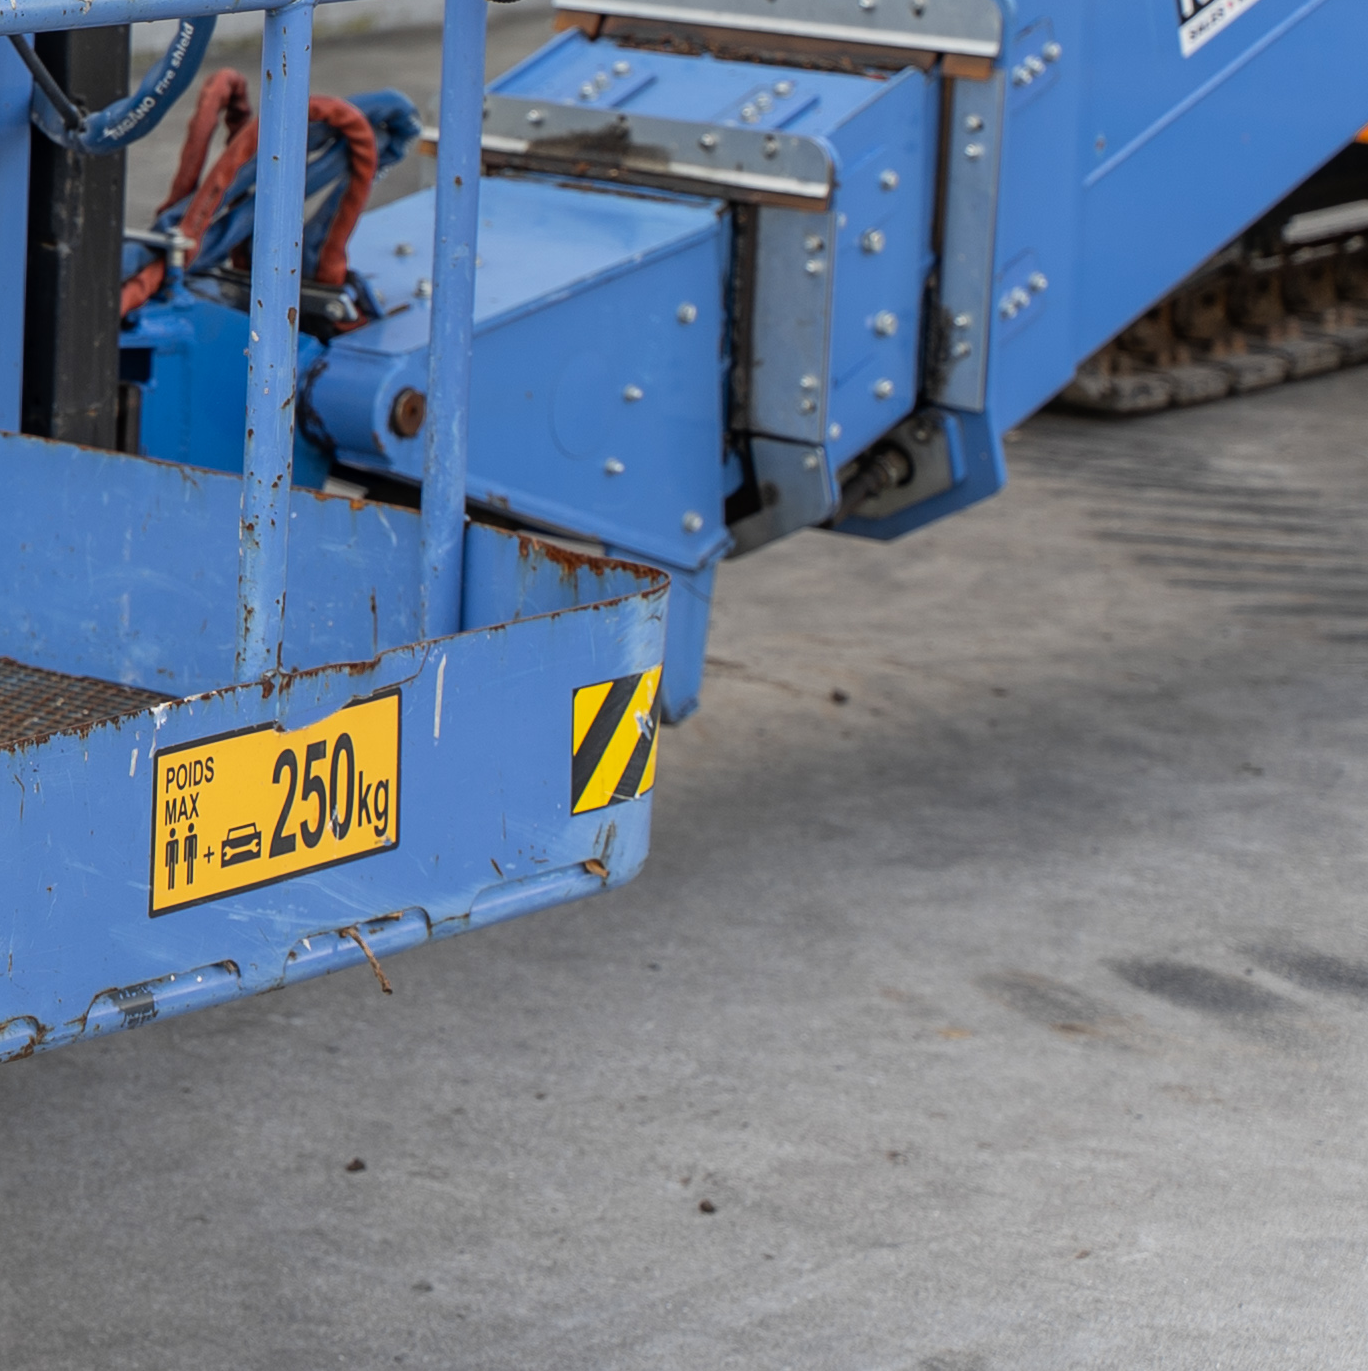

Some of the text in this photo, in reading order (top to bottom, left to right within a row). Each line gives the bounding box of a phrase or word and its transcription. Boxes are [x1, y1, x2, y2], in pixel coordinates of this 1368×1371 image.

[155, 69, 176, 95] Fire
[171, 21, 195, 68] shield
[166, 756, 214, 794] POIDS
[165, 792, 199, 826] MAX
